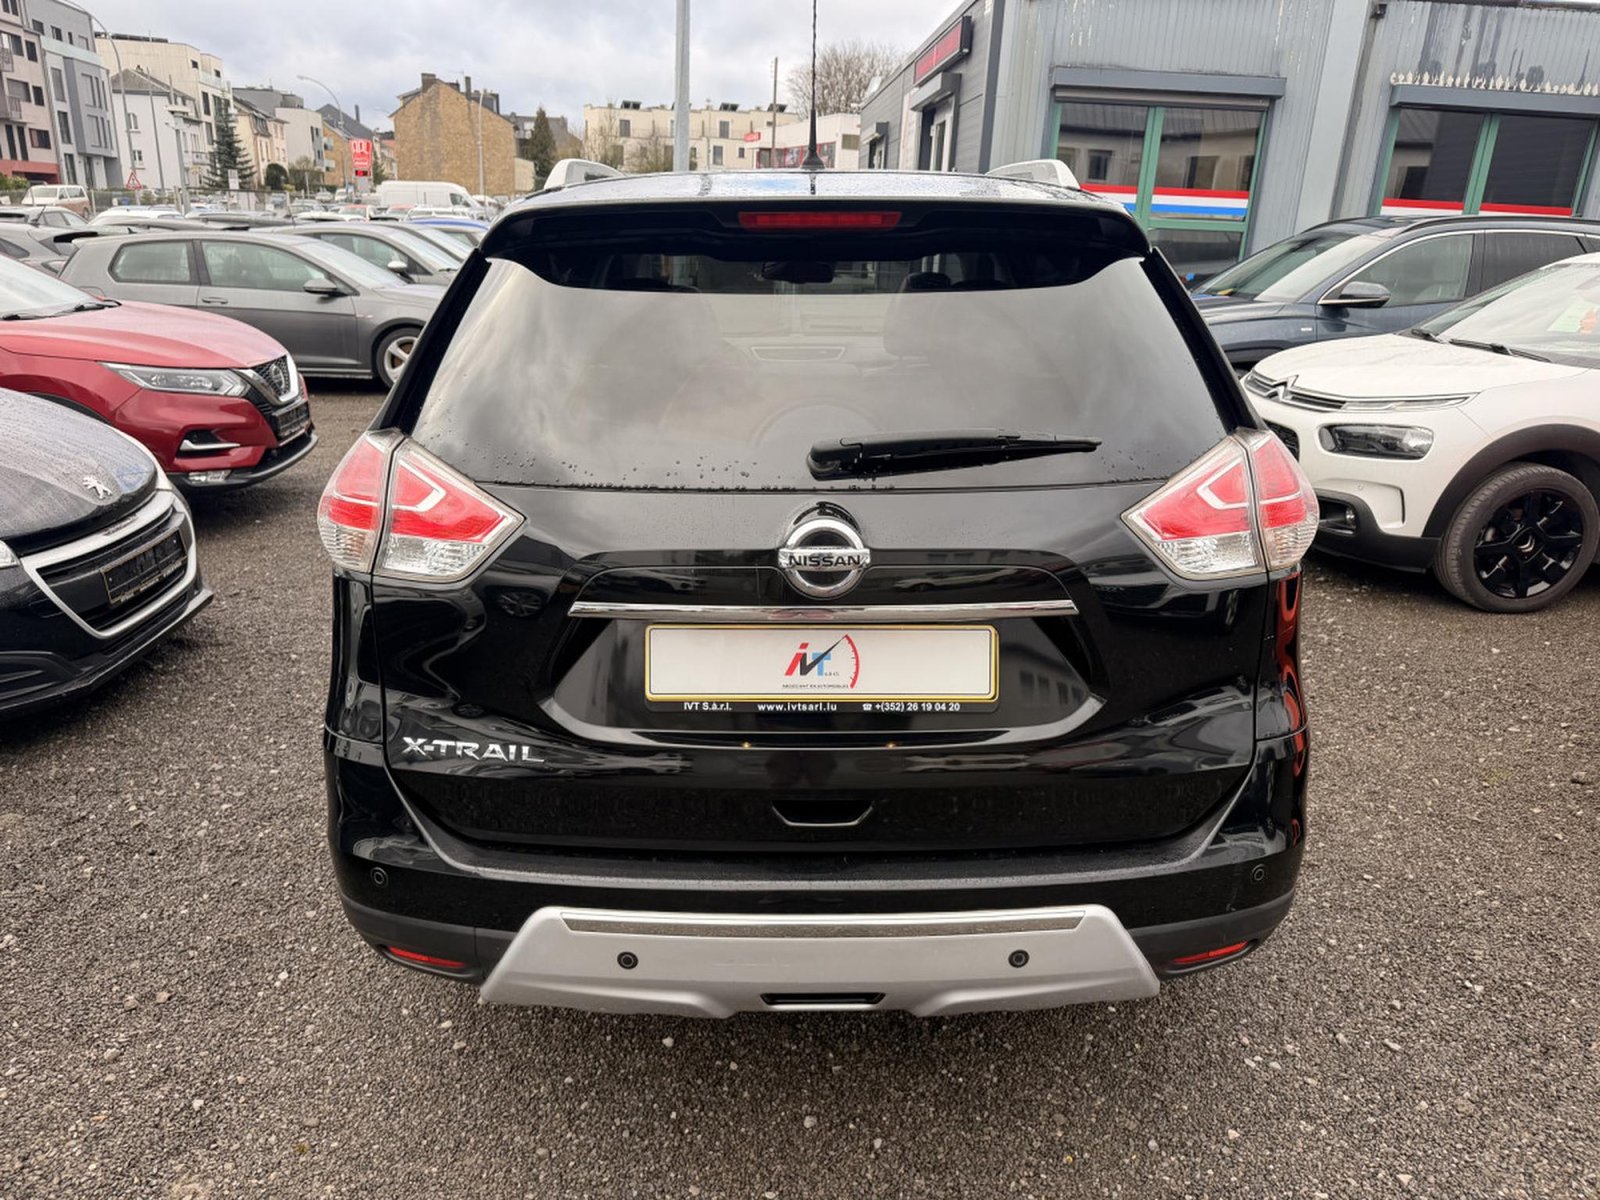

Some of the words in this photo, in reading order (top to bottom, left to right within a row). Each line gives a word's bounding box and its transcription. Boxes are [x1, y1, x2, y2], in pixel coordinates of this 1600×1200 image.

[789, 555, 860, 567] NISSAN
[683, 702, 700, 711] IVT
[757, 702, 837, 711] www.ivtsarl.lu
[875, 702, 905, 712] +(352)
[906, 702, 919, 711] 26
[921, 702, 931, 711] 19
[934, 702, 946, 711] 04
[948, 702, 960, 711] 20
[402, 736, 545, 762] X-TRAIL
